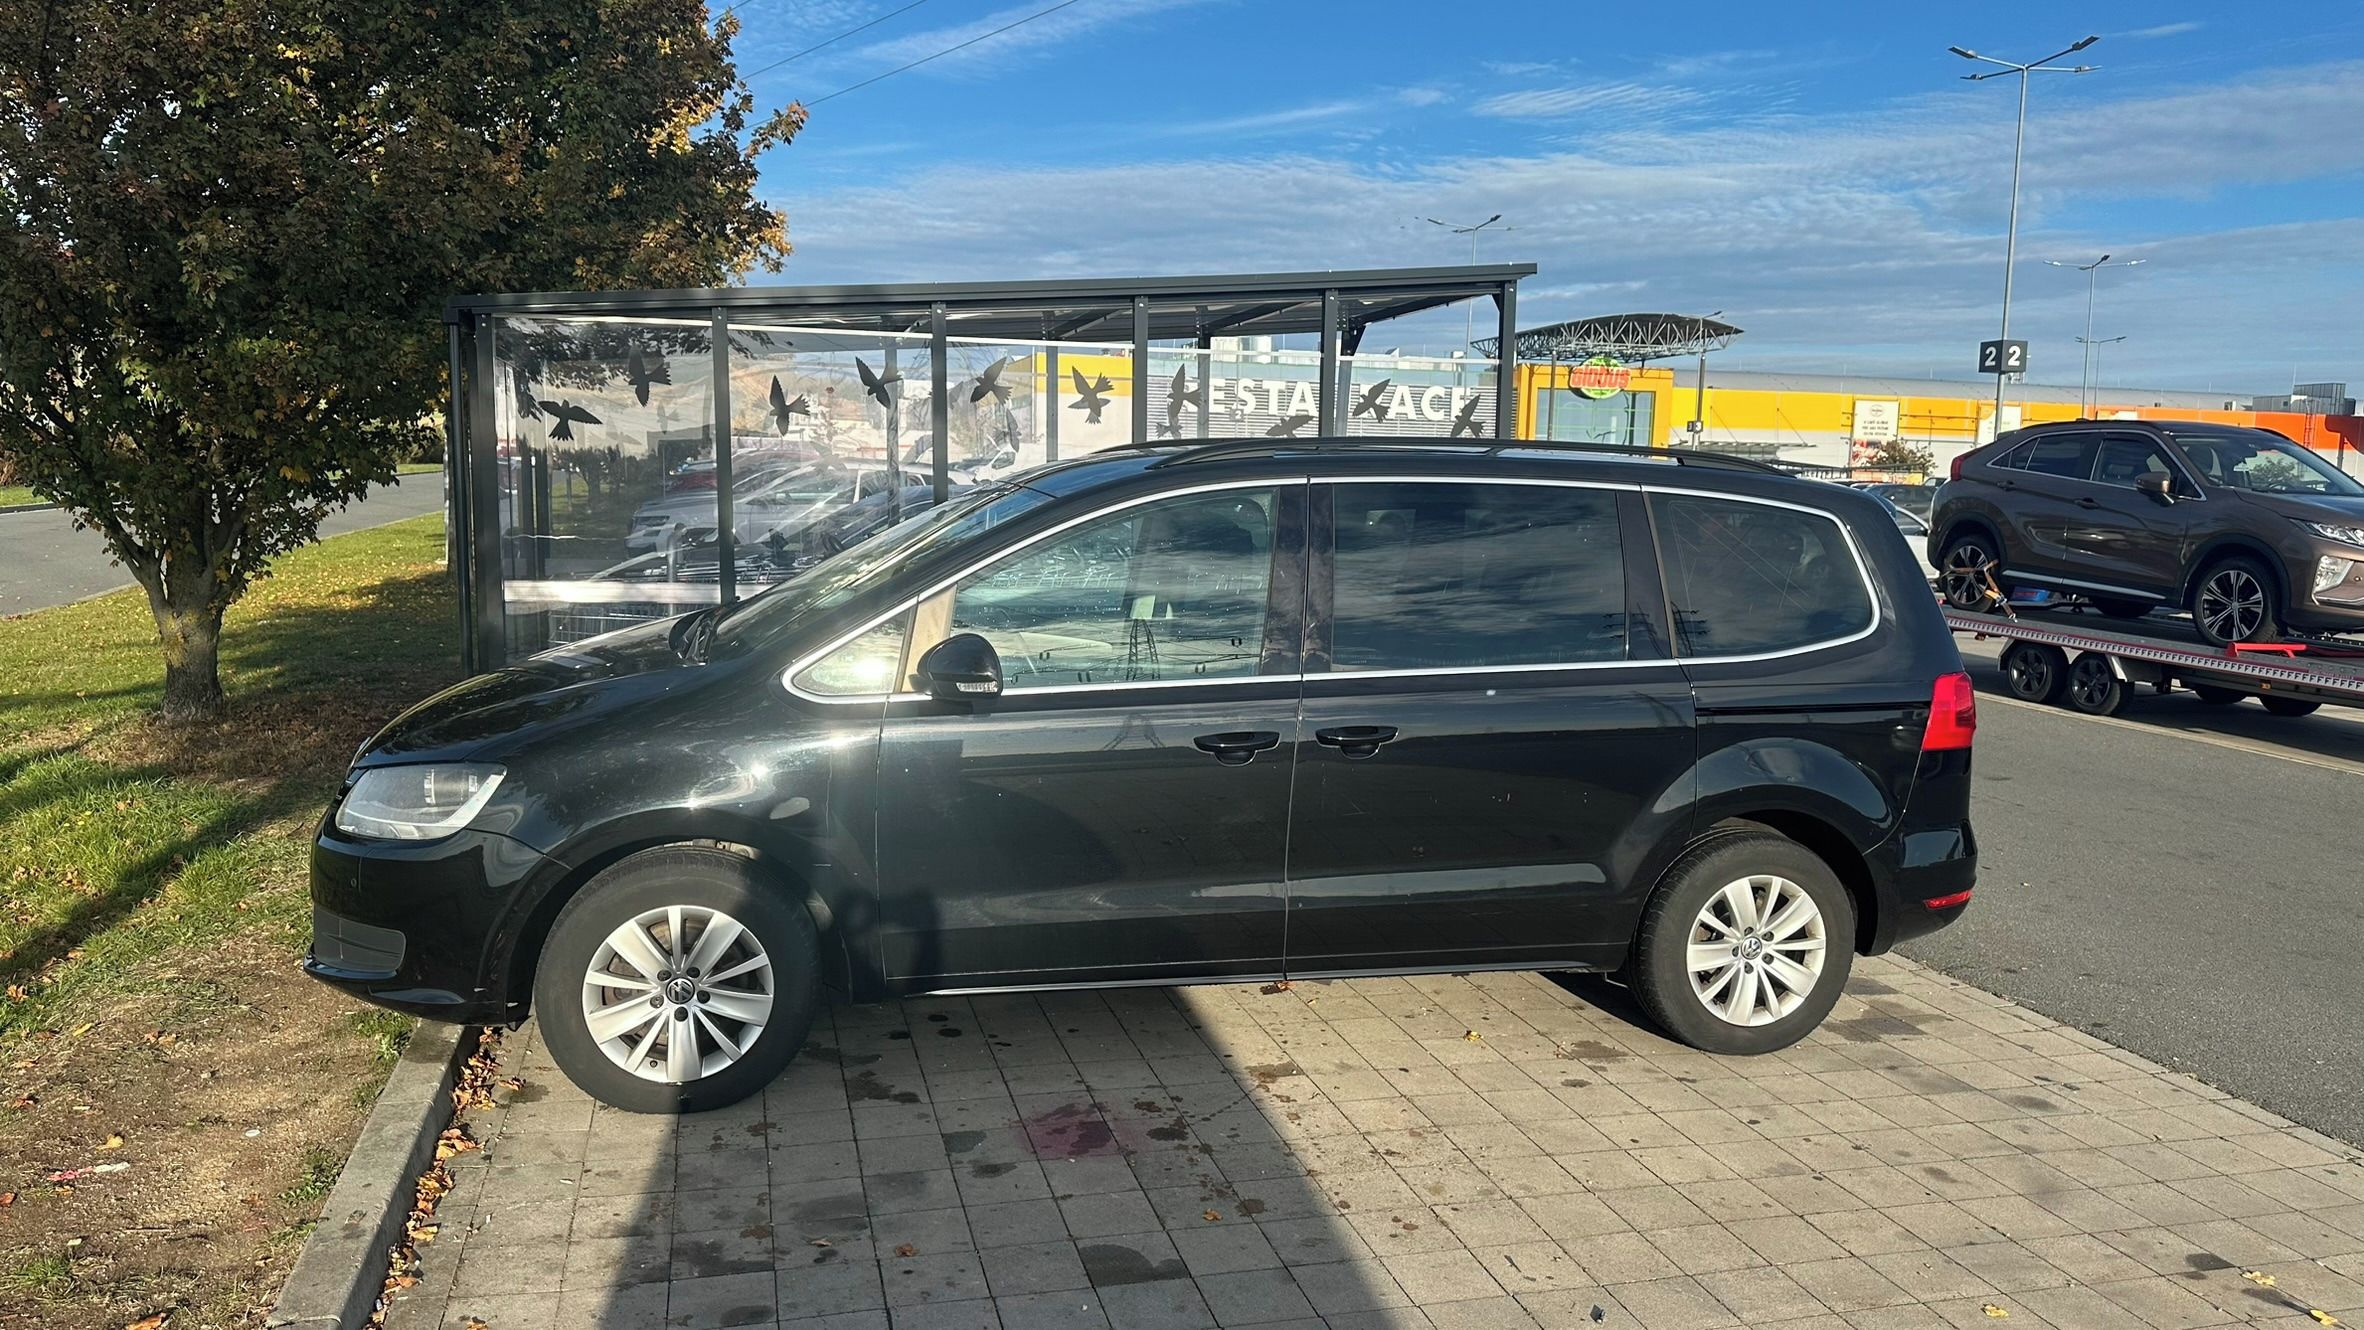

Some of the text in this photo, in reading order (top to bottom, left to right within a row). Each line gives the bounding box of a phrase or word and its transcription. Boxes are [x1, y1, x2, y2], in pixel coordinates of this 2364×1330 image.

[1984, 346, 1997, 367] 2
[2007, 345, 2021, 367] 2
[1695, 421, 1702, 431] 3
